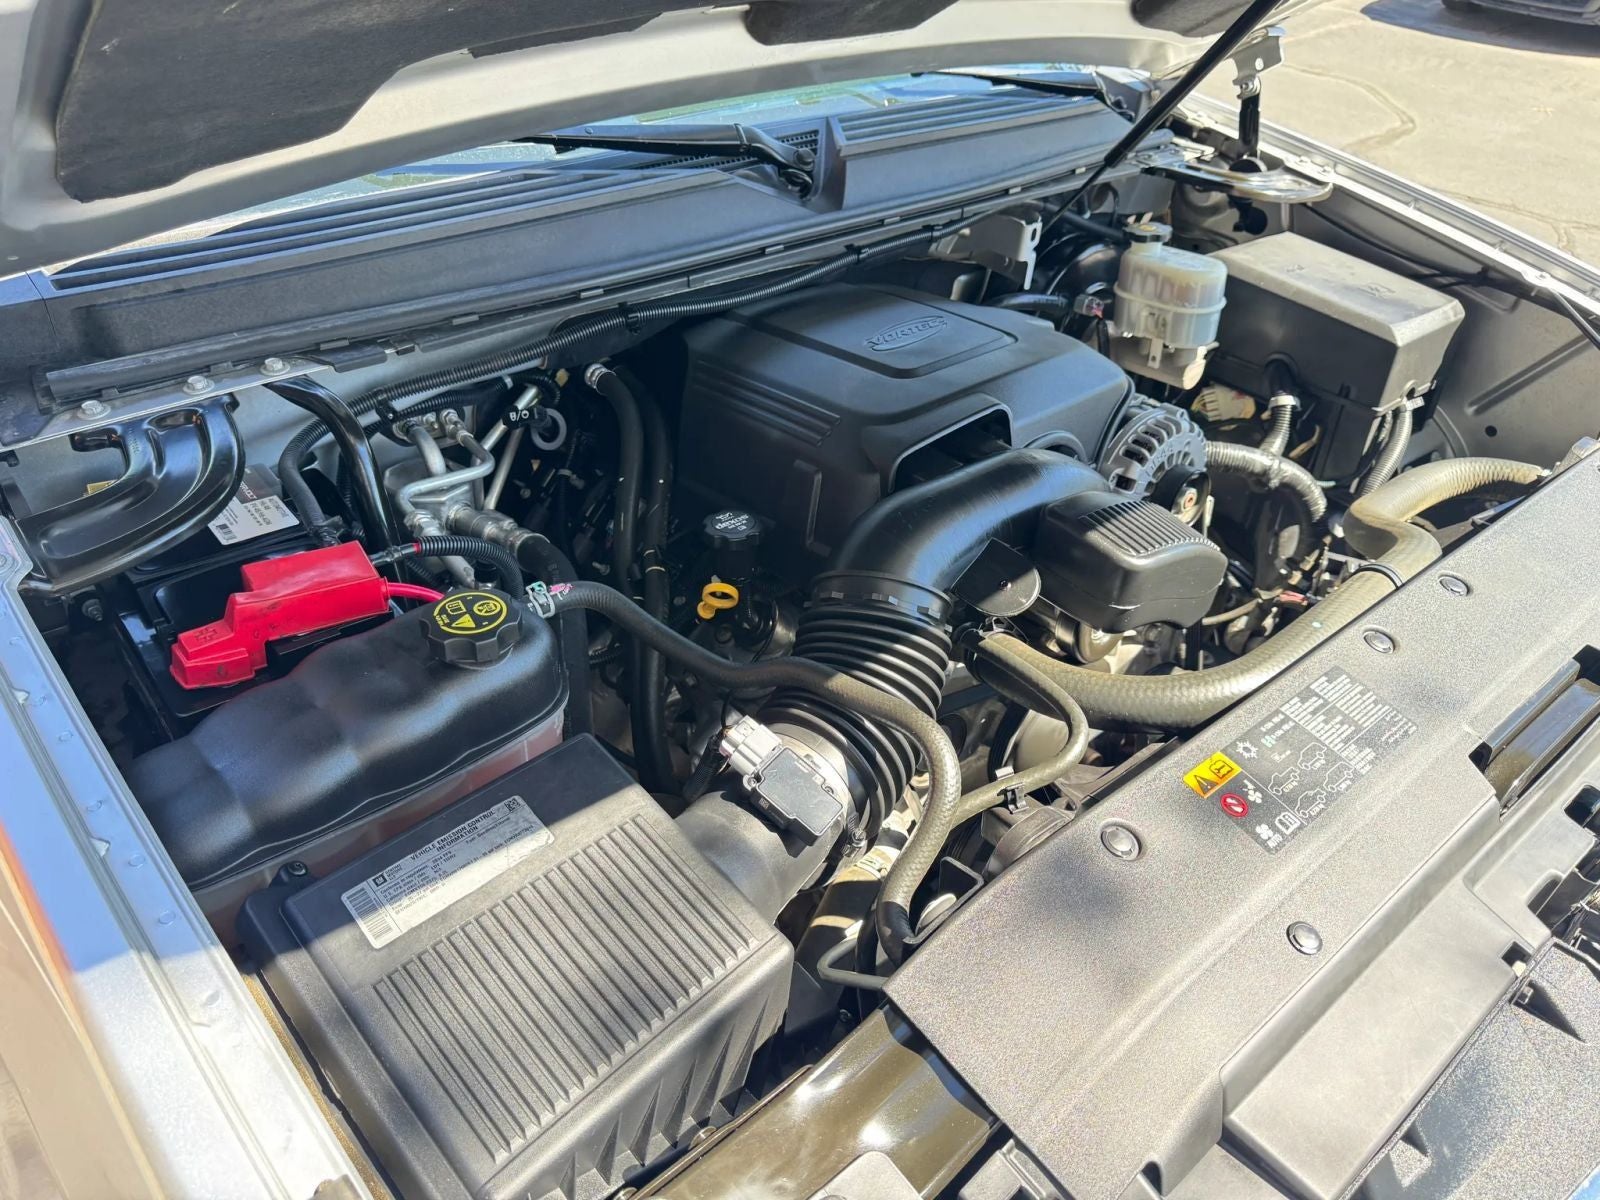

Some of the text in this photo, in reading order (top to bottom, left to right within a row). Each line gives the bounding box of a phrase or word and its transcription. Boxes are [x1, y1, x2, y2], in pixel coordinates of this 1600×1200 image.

[410, 843, 437, 861] VEHICLE
[436, 826, 467, 849] EMISSION
[468, 809, 495, 830] CONTROL
[436, 825, 479, 852] INFORMATION
